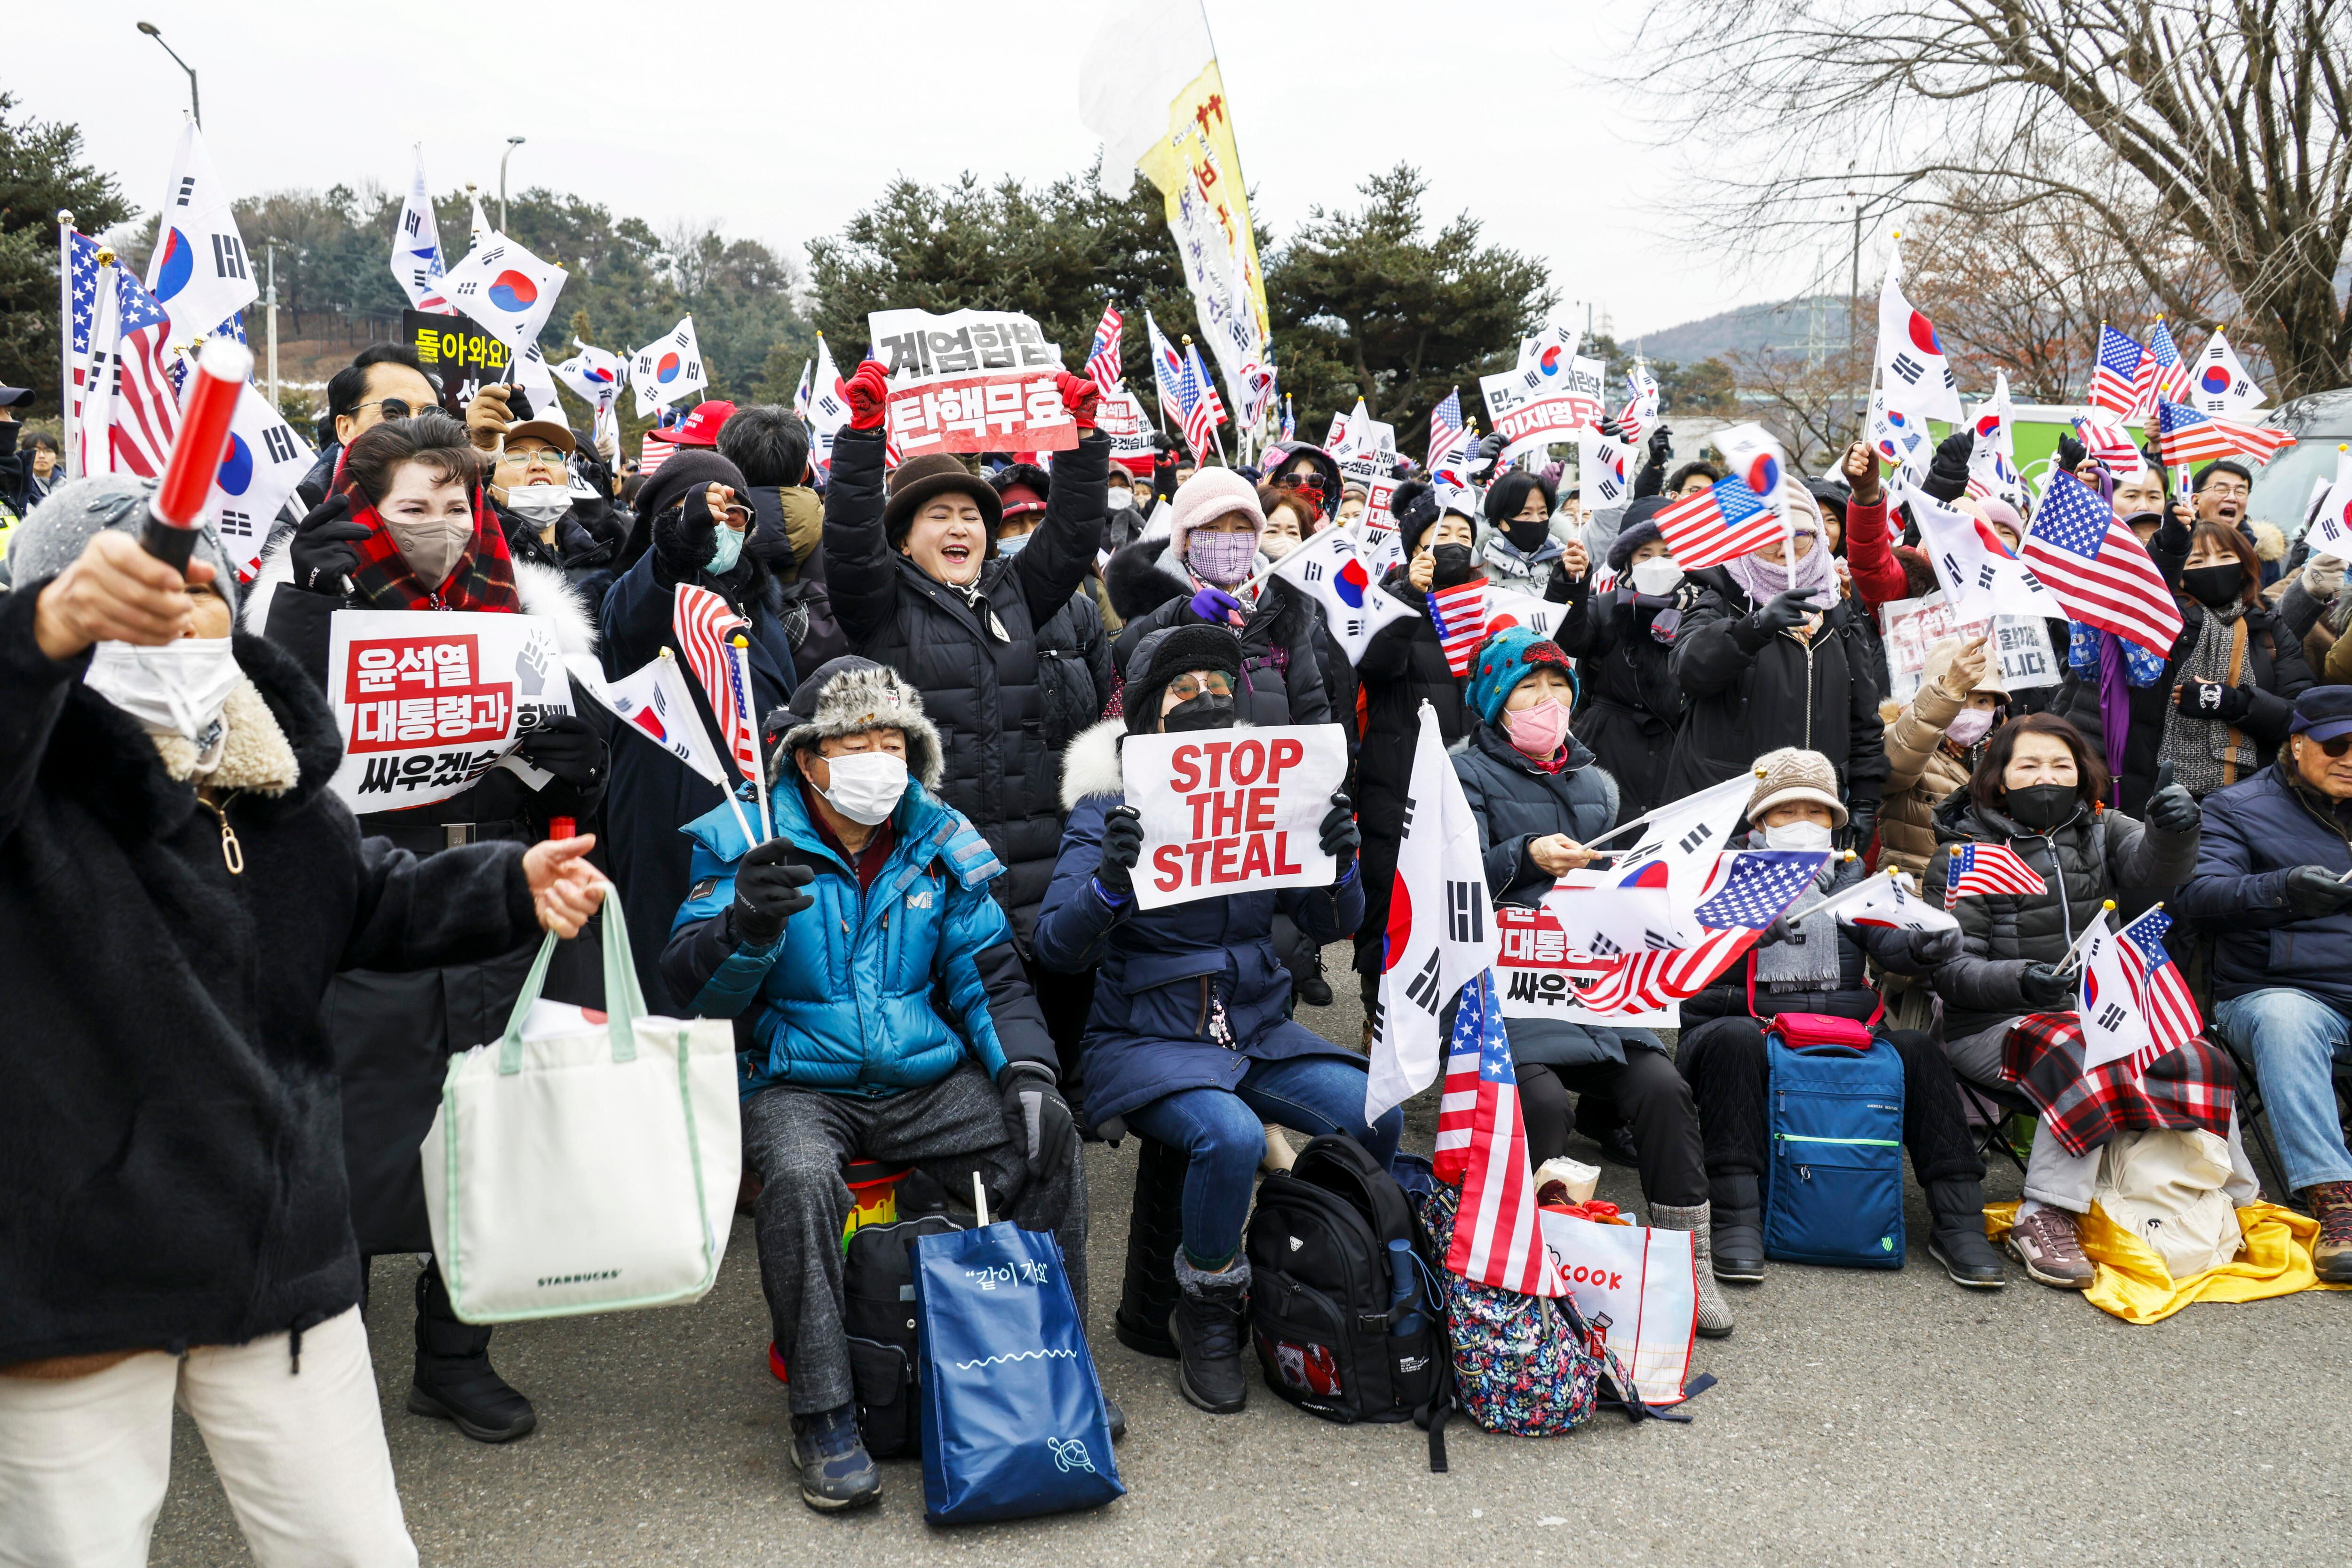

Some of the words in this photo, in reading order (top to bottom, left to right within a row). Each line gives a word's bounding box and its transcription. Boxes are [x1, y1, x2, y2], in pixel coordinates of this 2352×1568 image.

[881, 323, 1054, 380] 계엄합법
[890, 378, 1071, 450] 탄핵무효
[1500, 401, 1574, 440] 이재명
[309, 567, 320, 588] POLICE
[358, 644, 471, 693] 윤석열
[358, 692, 509, 742] 대통령과
[1170, 739, 1303, 792] STOP
[1123, 806, 1136, 815] NEPA
[1186, 788, 1279, 839] THE
[1153, 832, 1302, 892] STEAL
[537, 1269, 619, 1287] STARBUCKS
[1560, 1264, 1622, 1290] COOK
